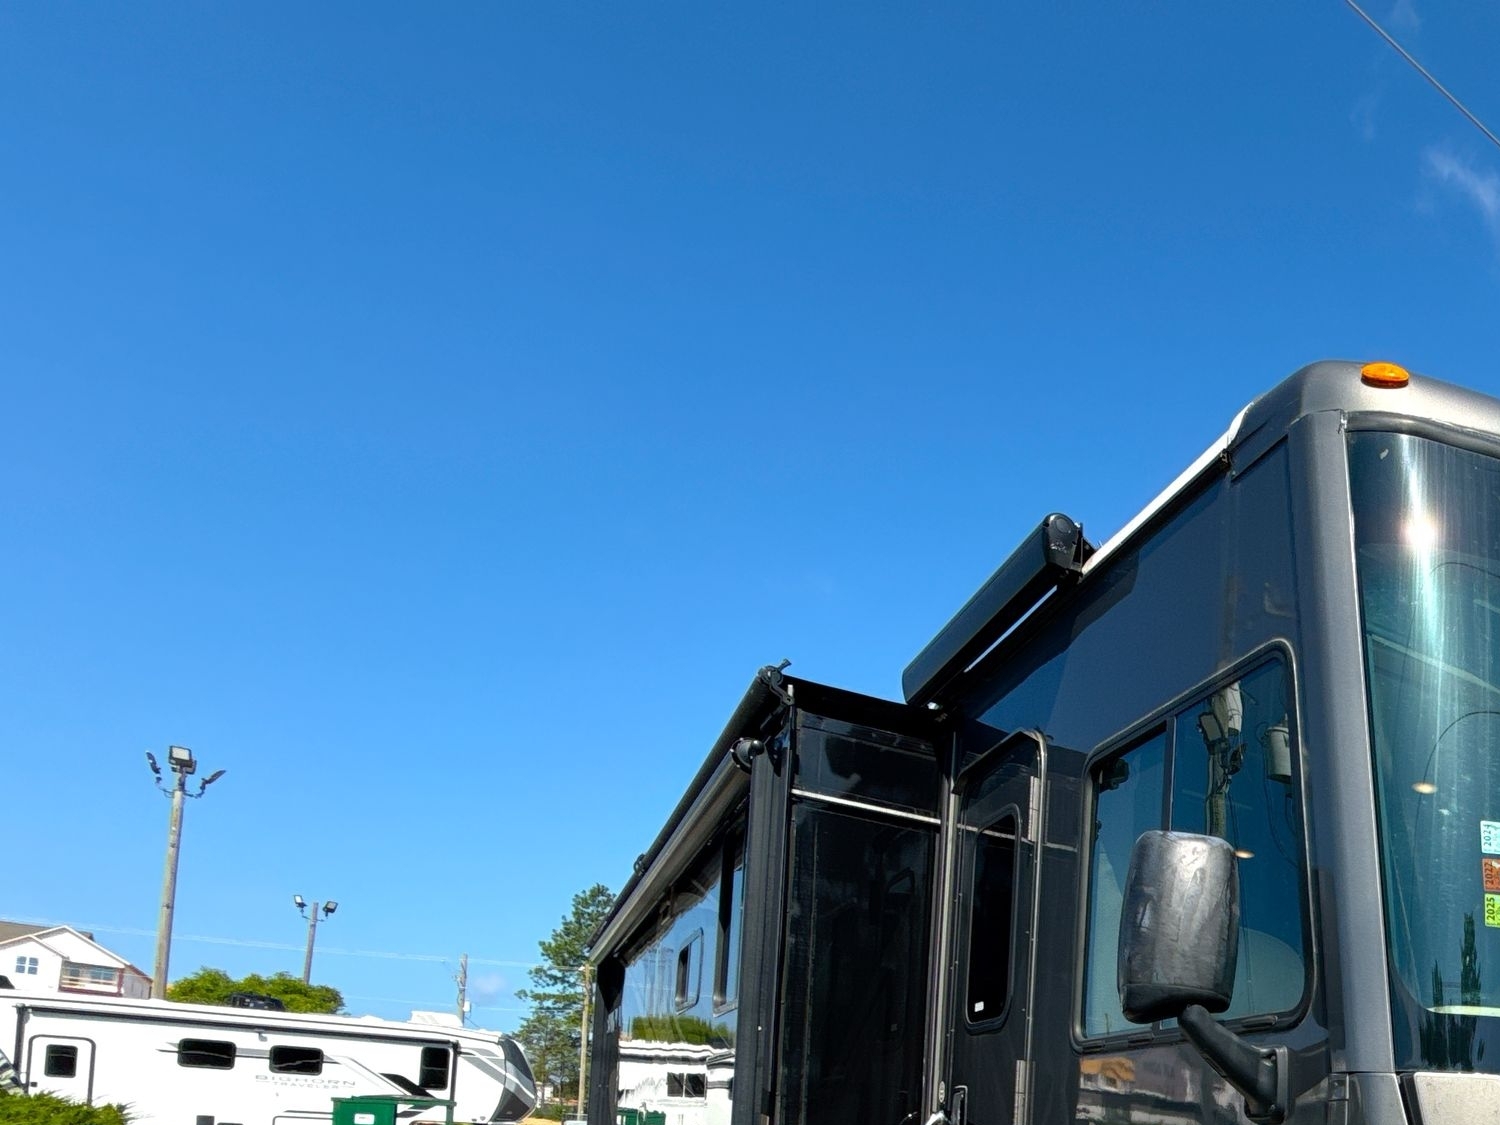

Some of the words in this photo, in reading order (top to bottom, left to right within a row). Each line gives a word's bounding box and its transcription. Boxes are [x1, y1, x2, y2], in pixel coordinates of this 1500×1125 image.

[1484, 897, 1496, 921] 2025
[255, 1074, 356, 1086] BIGHORN
[273, 1081, 339, 1089] TRAVELER
